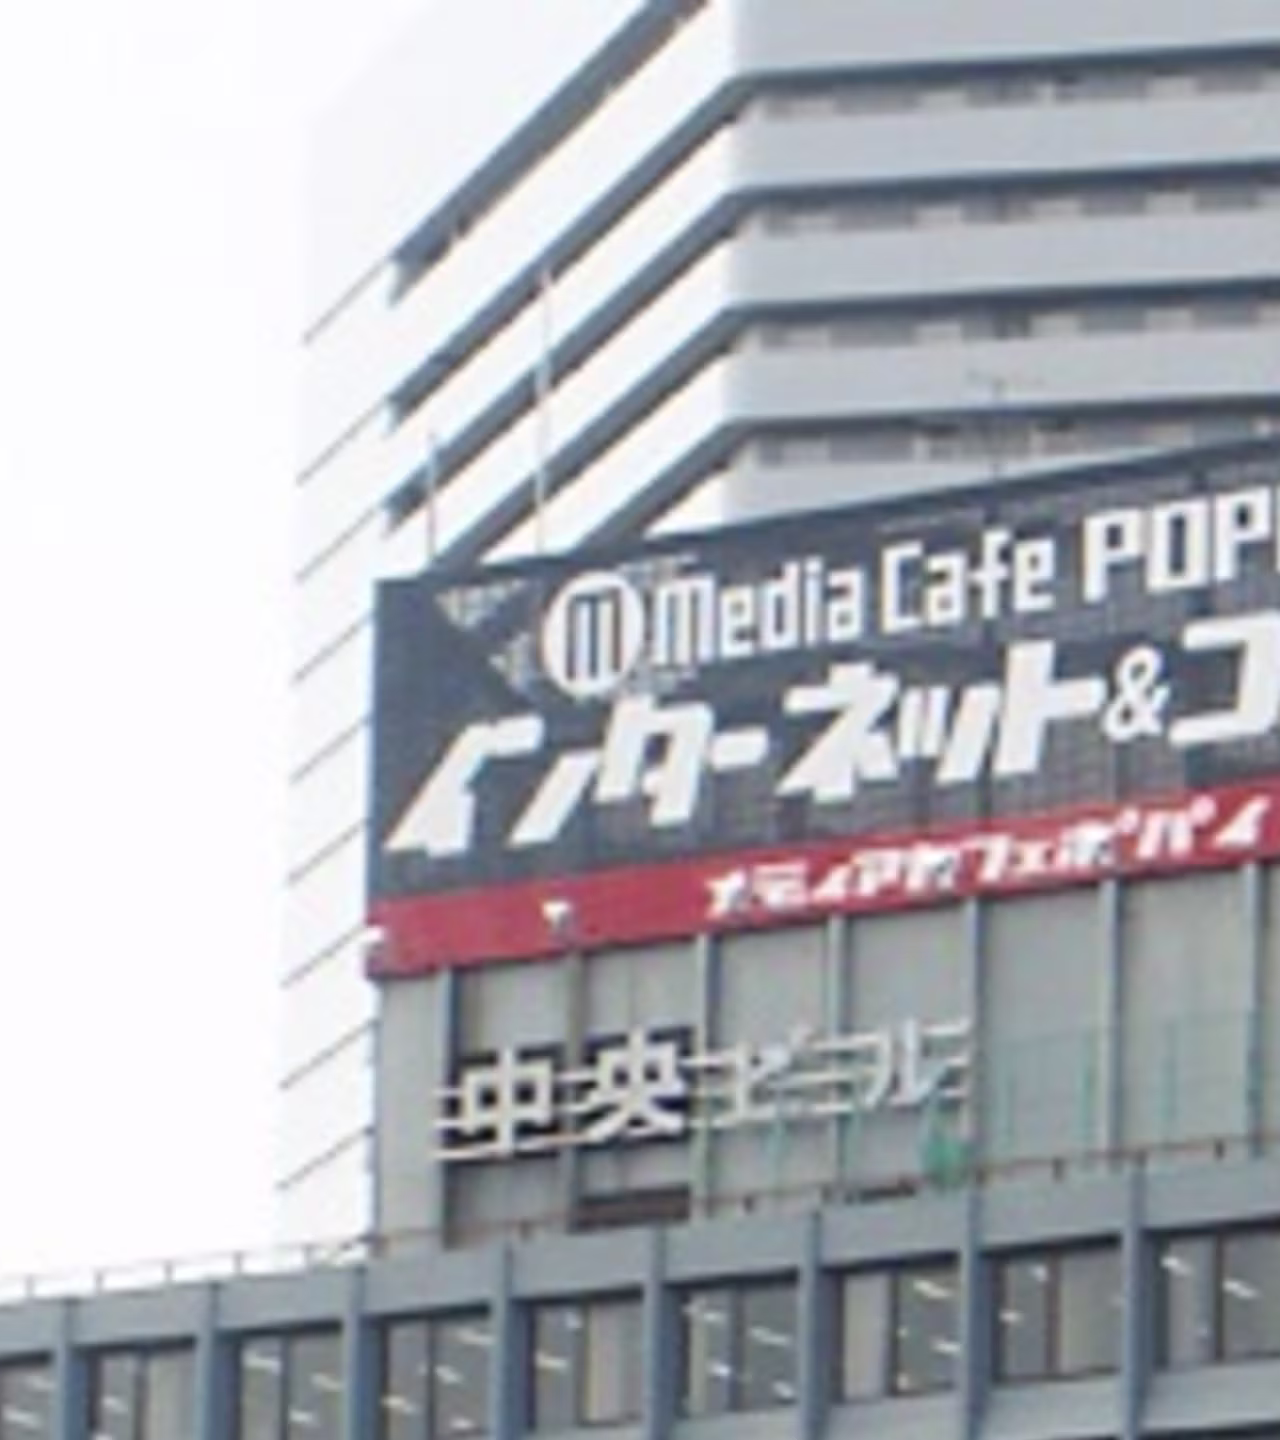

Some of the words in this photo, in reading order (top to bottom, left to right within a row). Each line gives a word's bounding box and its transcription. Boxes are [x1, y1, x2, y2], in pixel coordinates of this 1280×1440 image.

[880, 526, 1057, 634] Cafe
[456, 1014, 962, 1157] 中央ビル
